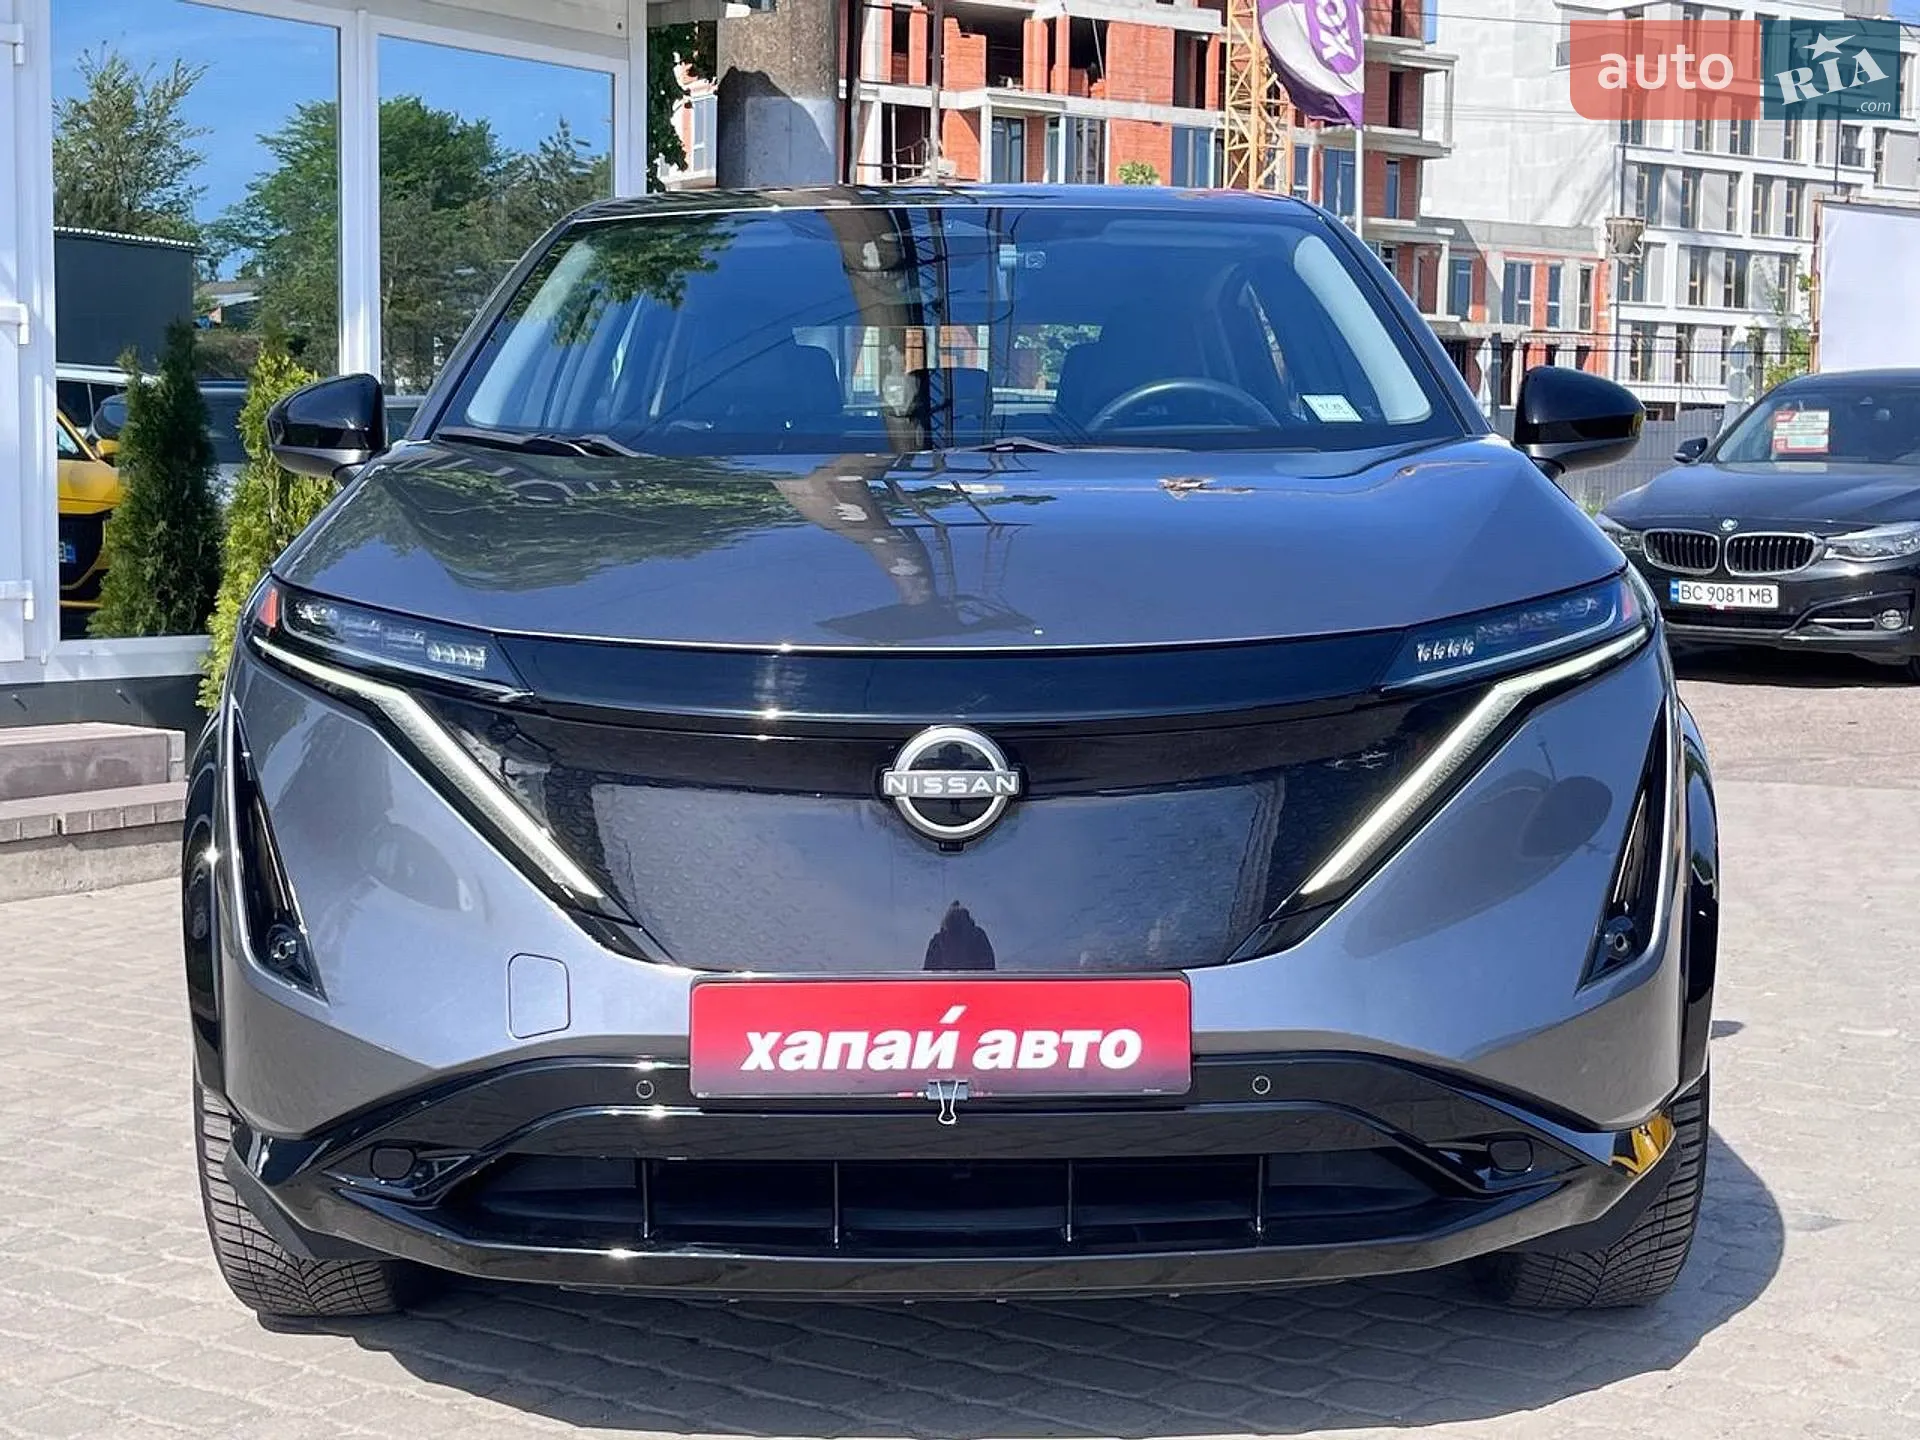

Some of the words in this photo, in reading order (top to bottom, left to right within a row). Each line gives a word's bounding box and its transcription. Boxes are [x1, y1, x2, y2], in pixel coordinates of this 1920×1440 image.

[1681, 584, 1703, 601] BC
[1707, 586, 1744, 603] 9081
[1749, 588, 1773, 604] MB
[887, 776, 1017, 794] NISSAN
[971, 1028, 1142, 1070] авто
